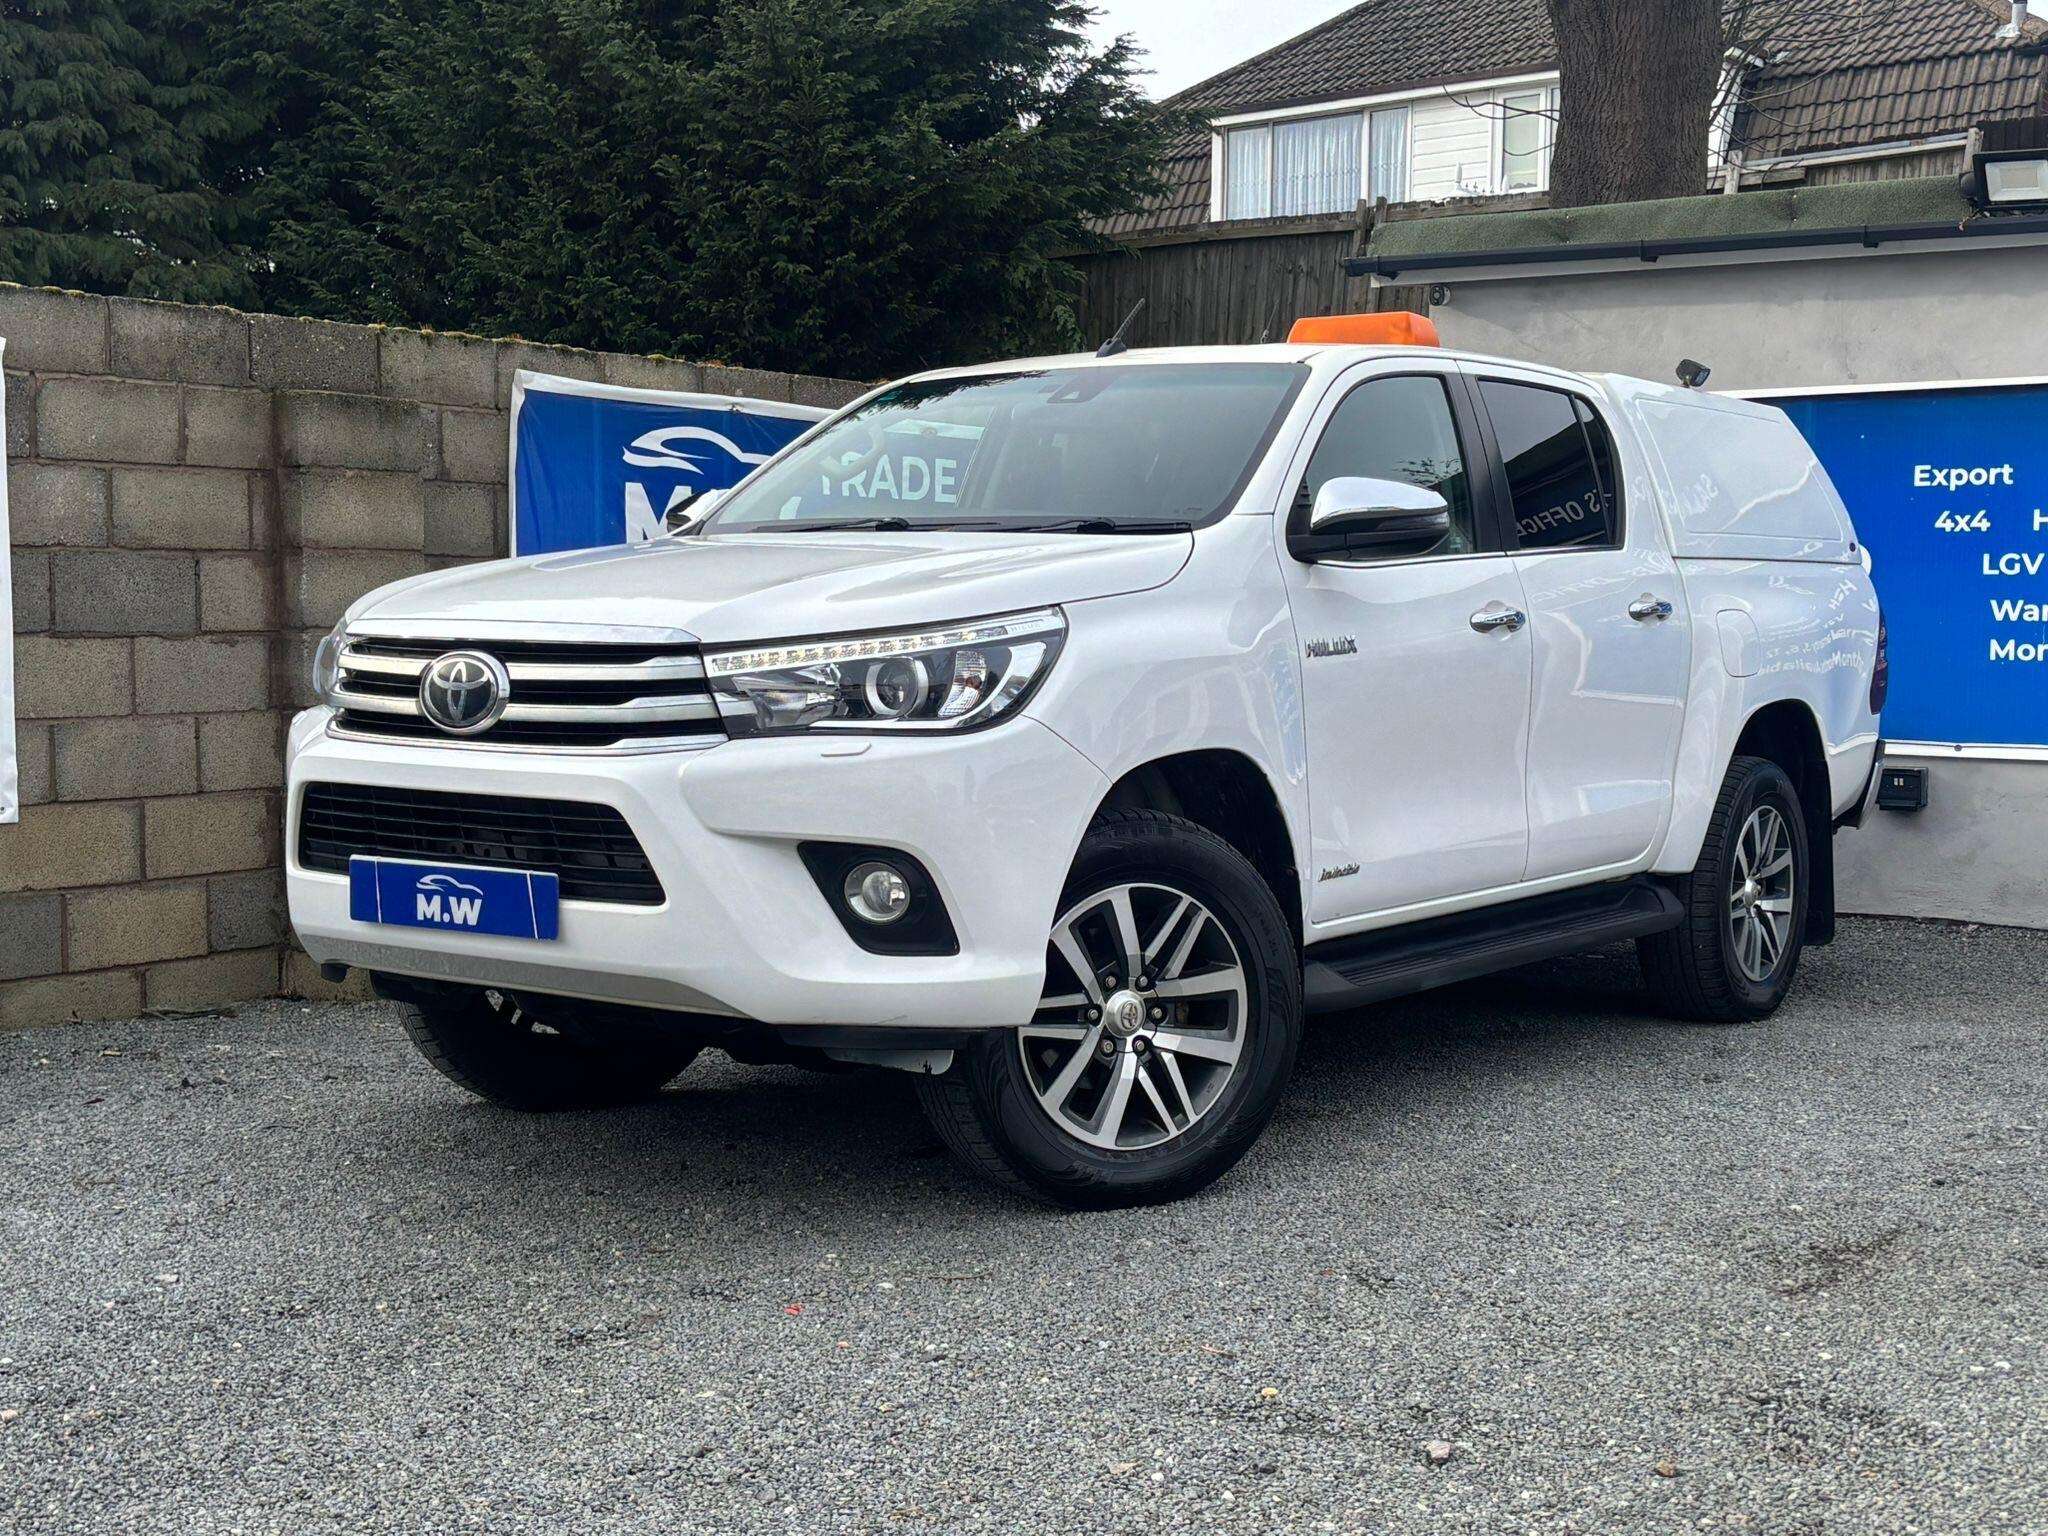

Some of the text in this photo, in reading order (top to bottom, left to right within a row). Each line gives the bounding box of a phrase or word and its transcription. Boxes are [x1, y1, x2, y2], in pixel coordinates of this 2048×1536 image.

[1913, 464, 2014, 491] Export
[1934, 509, 1991, 532] 4x4
[1983, 552, 2045, 575] LGV
[416, 893, 483, 926] M.W
